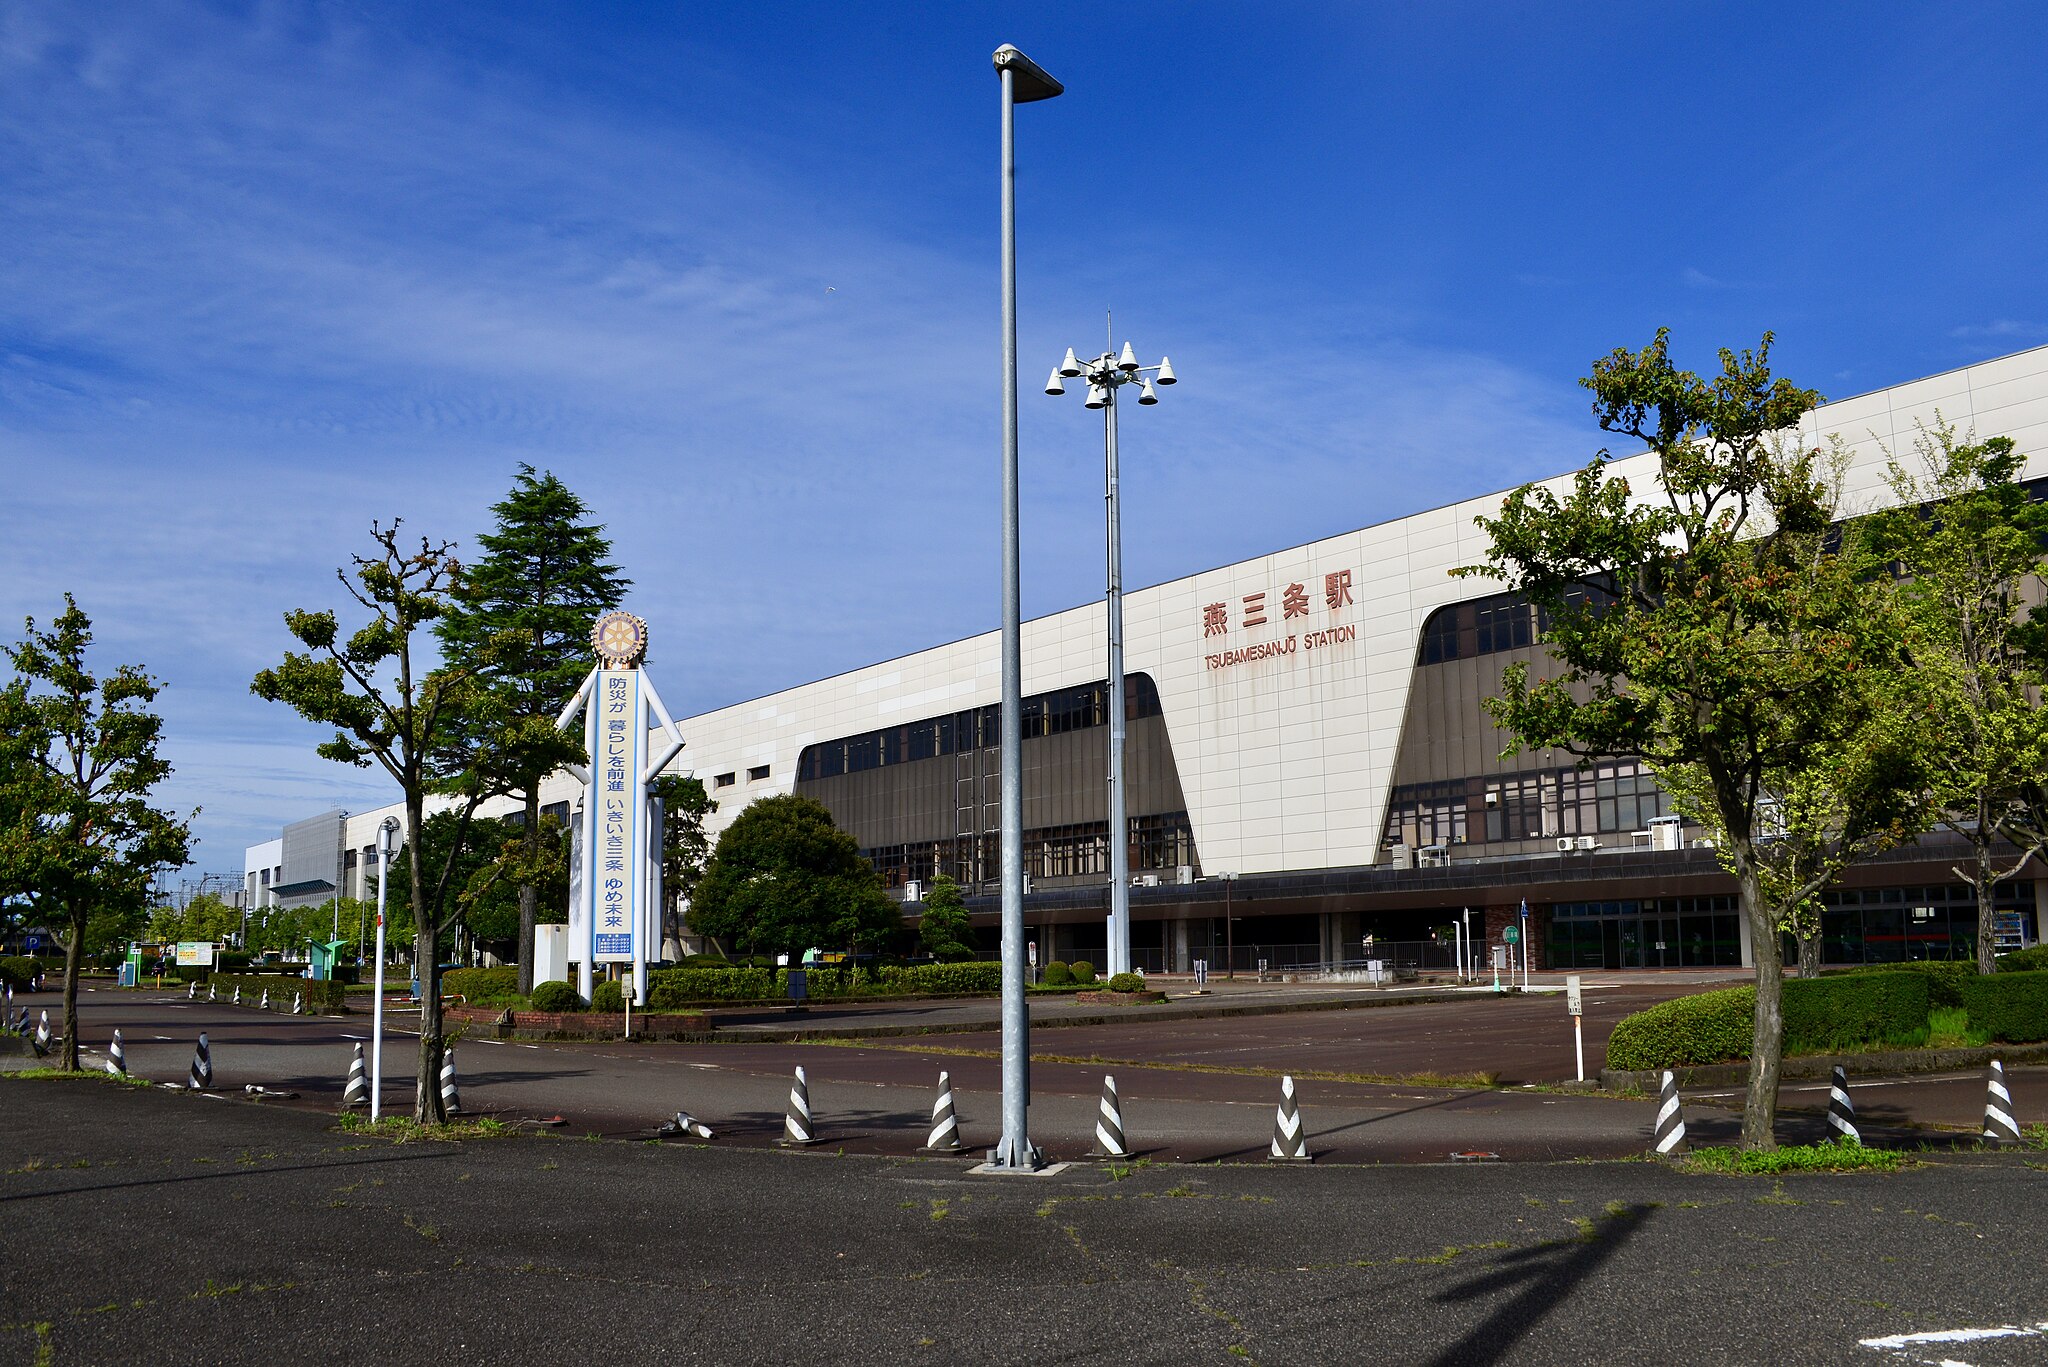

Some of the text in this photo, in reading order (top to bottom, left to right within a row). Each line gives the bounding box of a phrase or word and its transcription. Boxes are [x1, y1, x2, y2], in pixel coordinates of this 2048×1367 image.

[1203, 570, 1354, 638] 燕三条駅
[1205, 625, 1356, 670] TSUBAMESANJŌ STATION
[609, 677, 627, 713] 防災が
[607, 720, 627, 792] 暮らしを前進
[605, 799, 624, 872] いきいき三条
[605, 878, 623, 927] ゆめ未来
